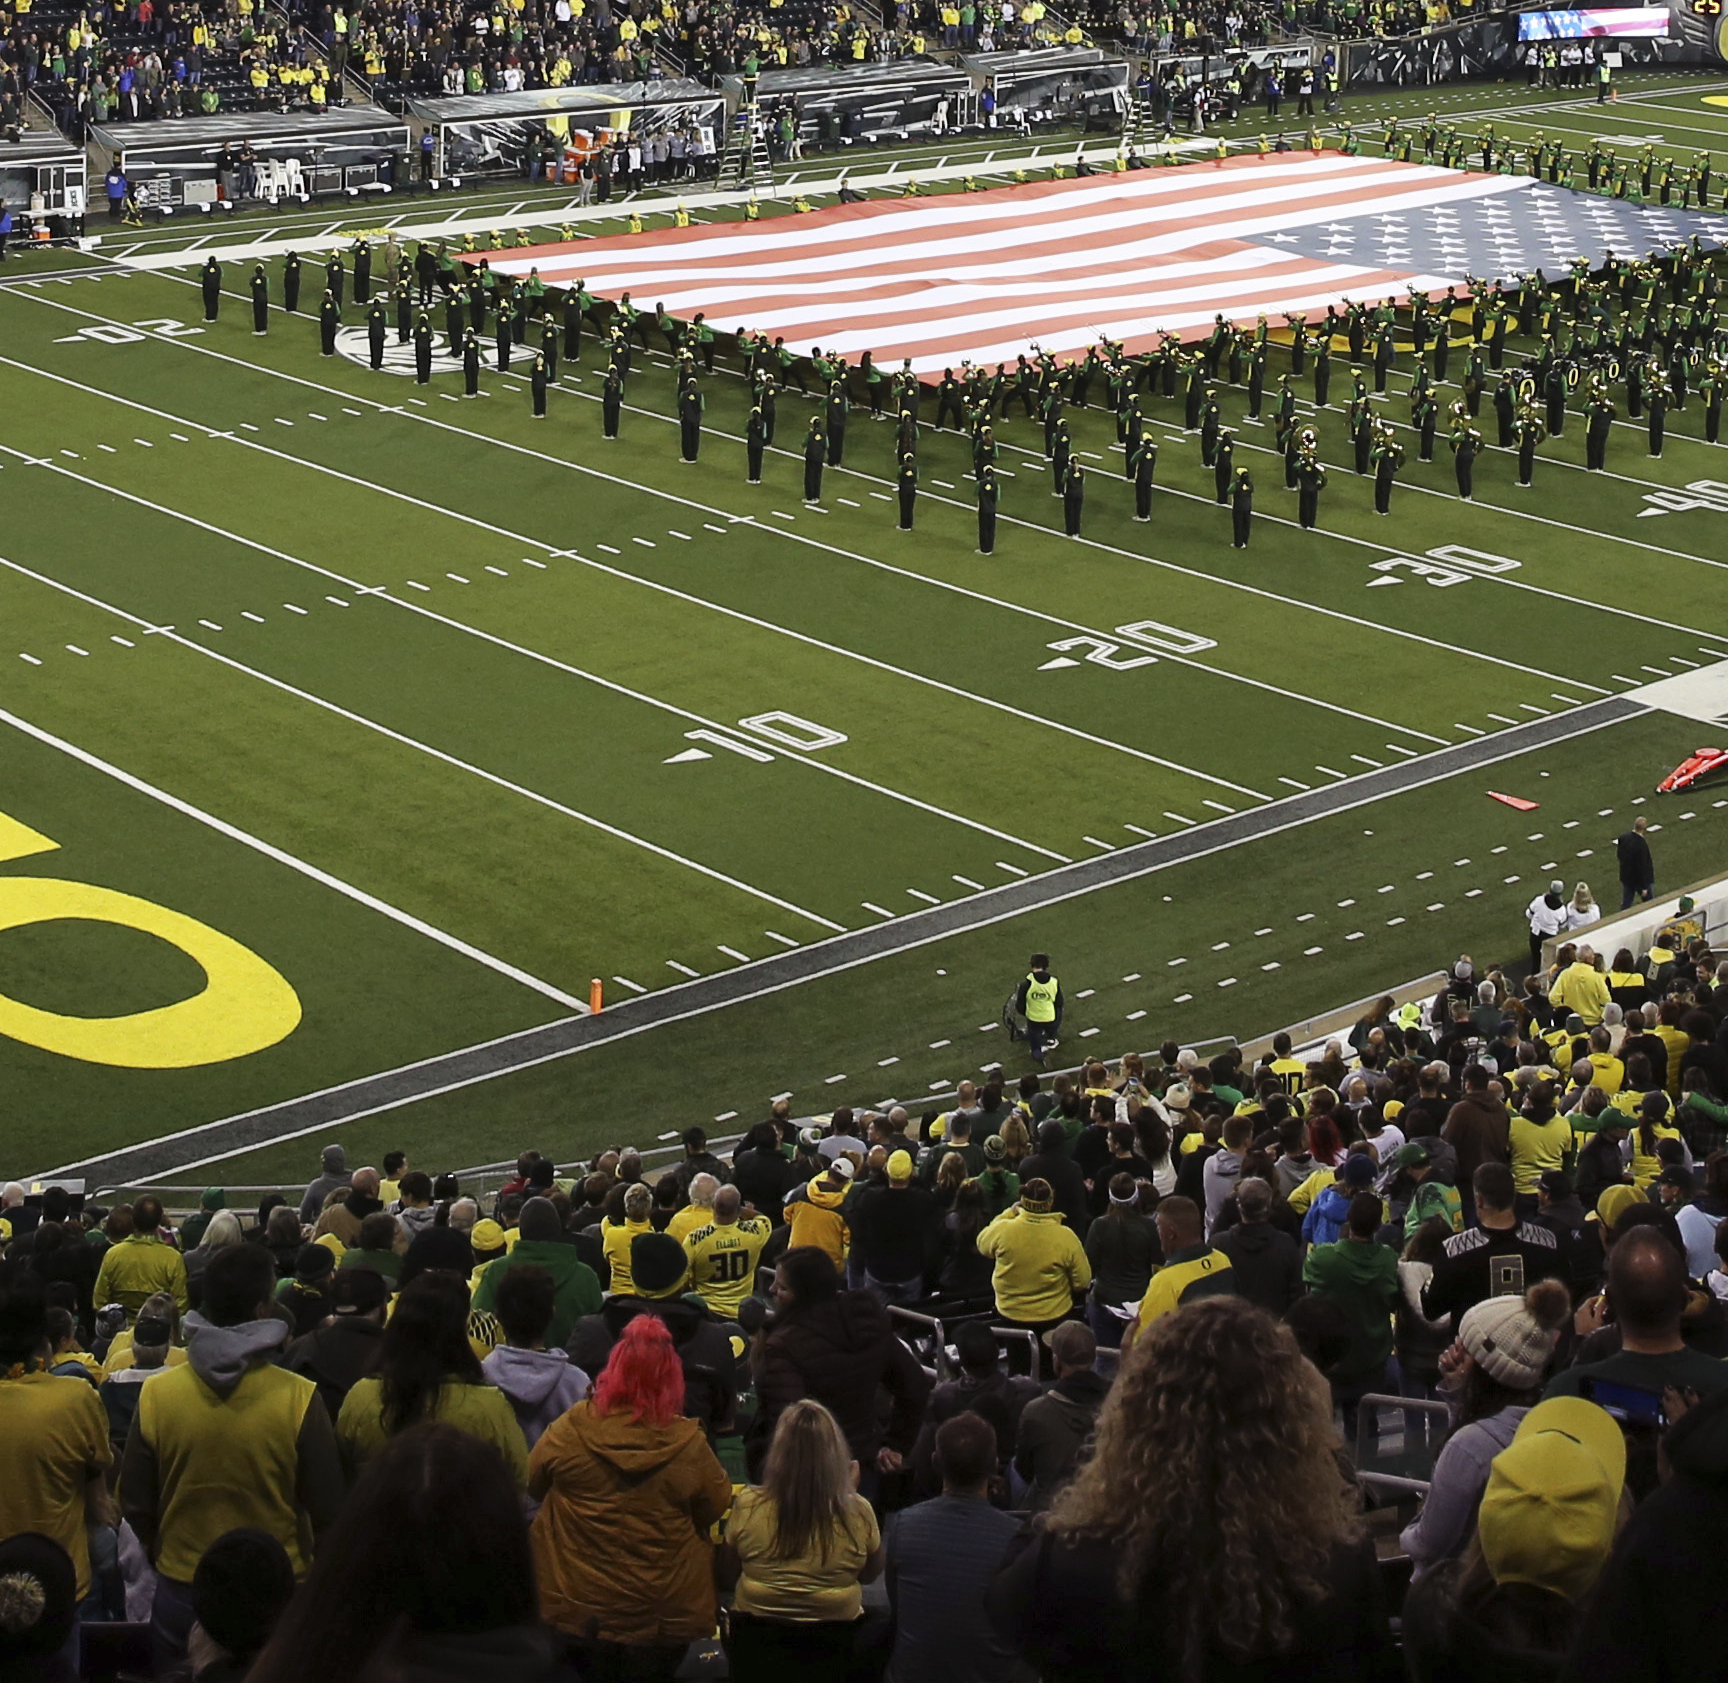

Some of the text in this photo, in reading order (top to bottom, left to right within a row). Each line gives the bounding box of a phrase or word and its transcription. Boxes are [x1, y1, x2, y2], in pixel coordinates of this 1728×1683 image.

[76, 318, 205, 344] 20
[1369, 543, 1523, 587] 30
[1045, 621, 1220, 671] 20
[683, 710, 849, 763] 10
[708, 1248, 750, 1282] 30
